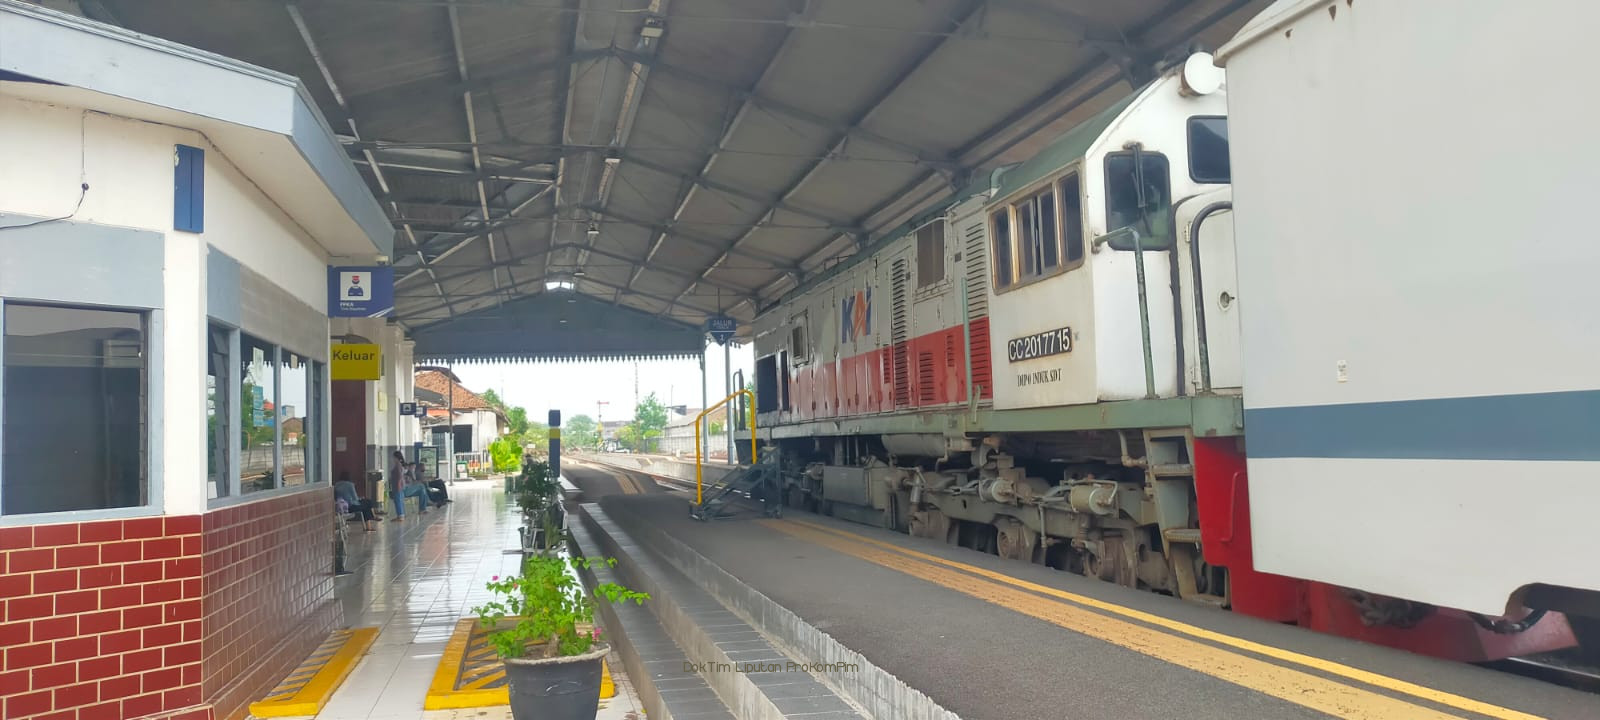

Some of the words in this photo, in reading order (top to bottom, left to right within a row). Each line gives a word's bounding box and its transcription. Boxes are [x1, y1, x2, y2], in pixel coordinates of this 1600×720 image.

[841, 287, 872, 344] KAI
[332, 350, 375, 361] Keluar
[1017, 373, 1031, 387] DIPO
[1032, 370, 1049, 385] INDUK
[1050, 368, 1062, 382] SDT
